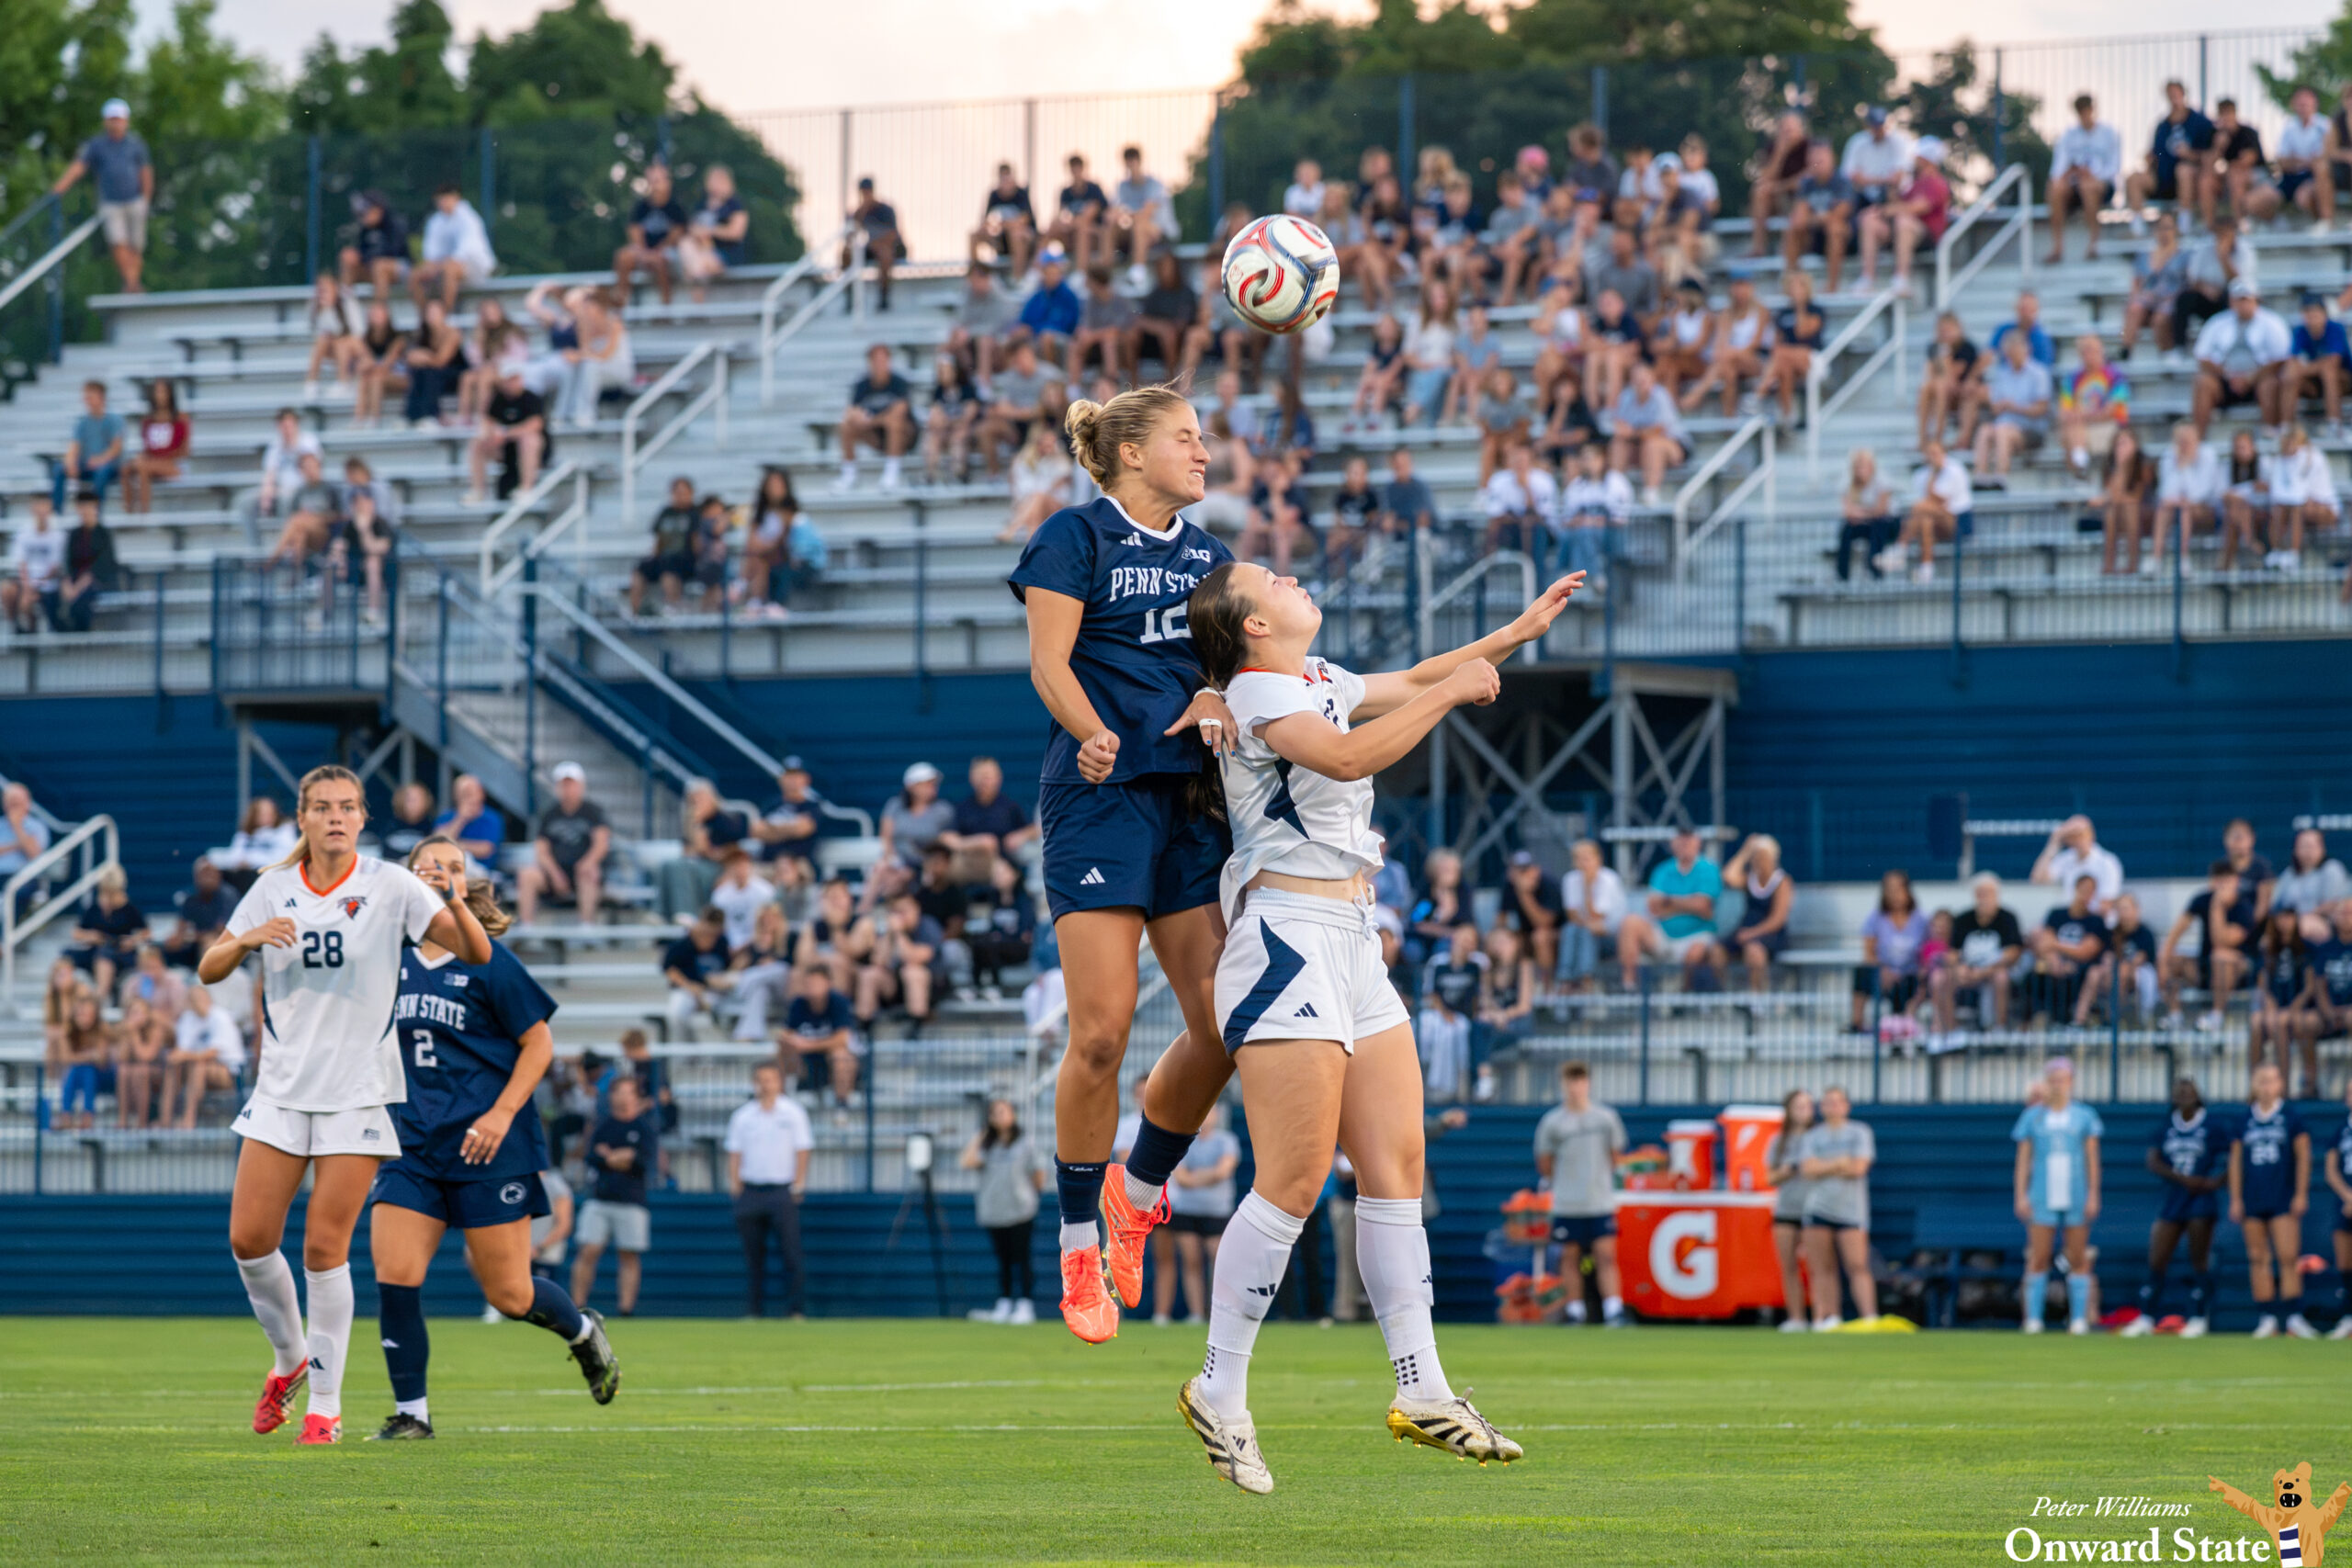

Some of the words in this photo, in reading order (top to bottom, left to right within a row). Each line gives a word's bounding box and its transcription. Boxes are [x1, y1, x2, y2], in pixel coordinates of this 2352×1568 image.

[1109, 567, 1163, 602] PENN
[302, 931, 344, 968] 28
[419, 993, 467, 1031] STATE
[413, 1029, 437, 1067] 2
[1648, 1210, 1718, 1300] G
